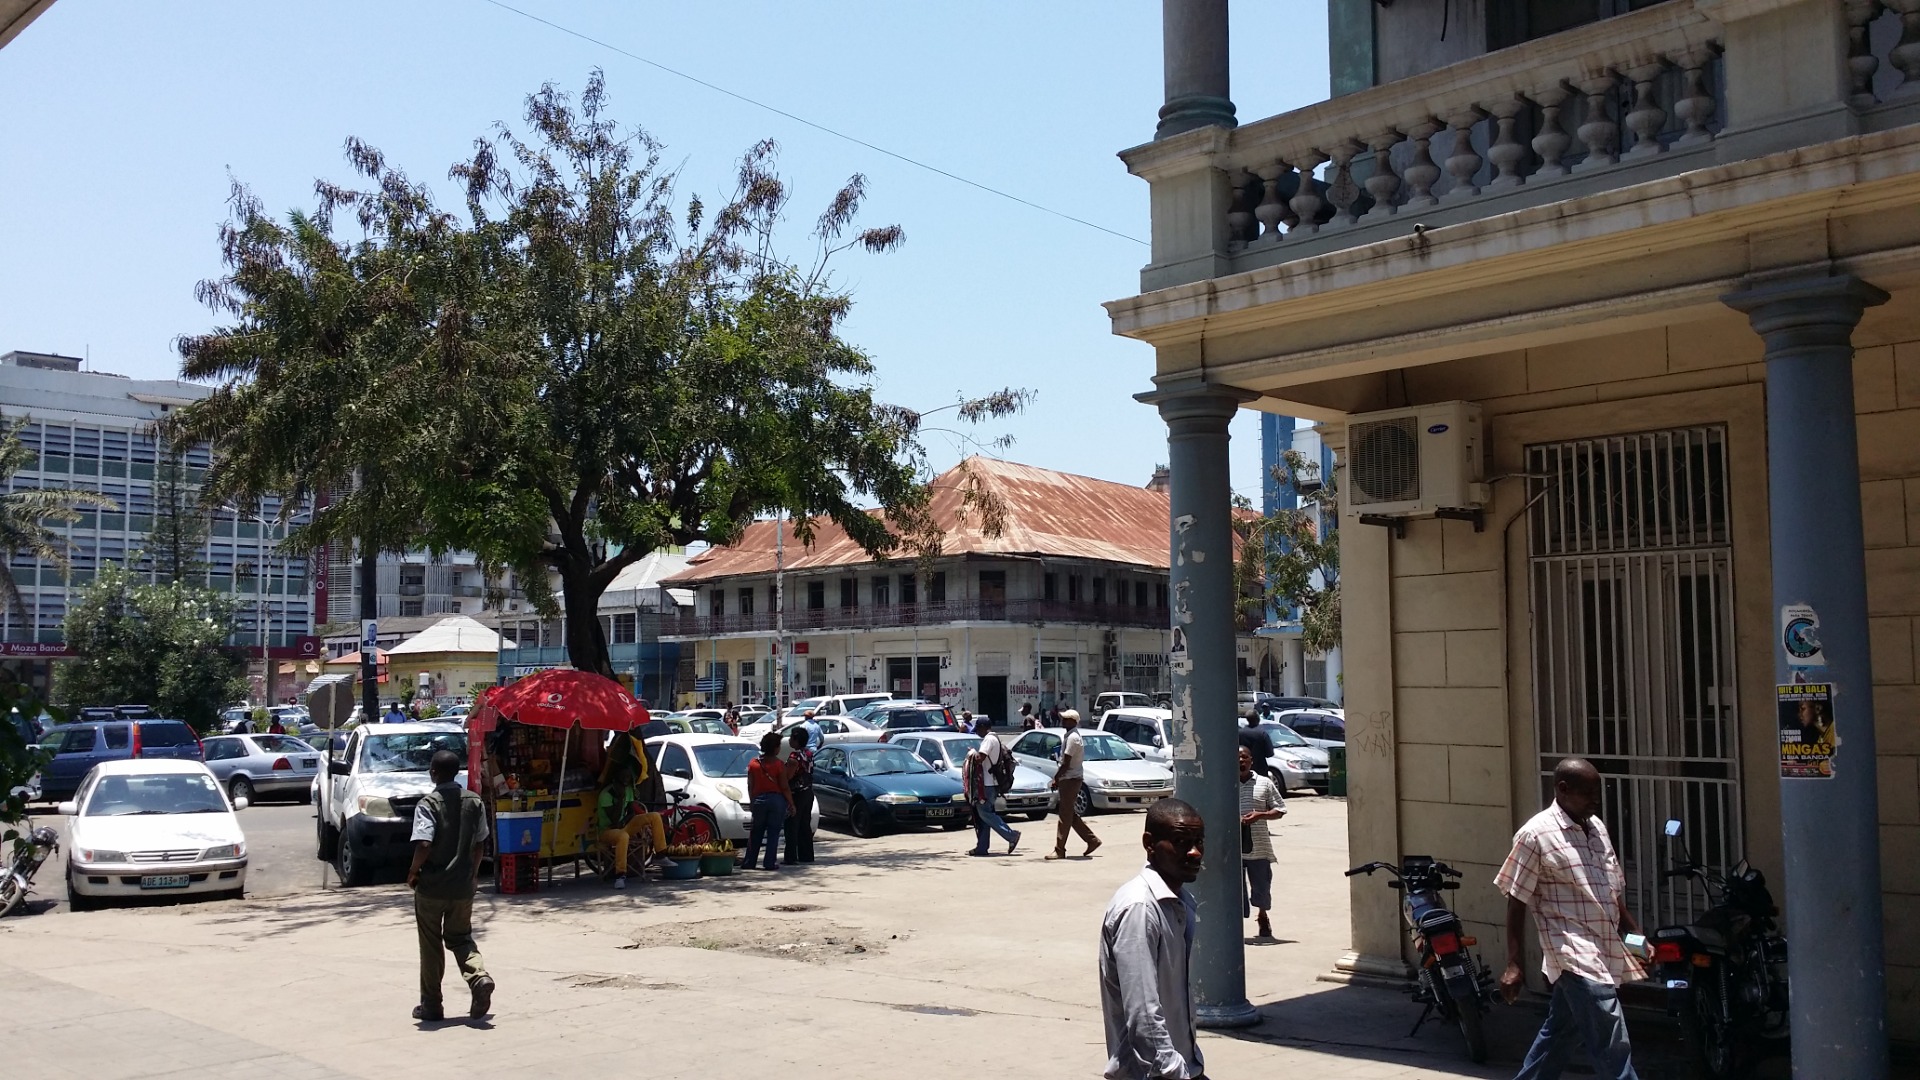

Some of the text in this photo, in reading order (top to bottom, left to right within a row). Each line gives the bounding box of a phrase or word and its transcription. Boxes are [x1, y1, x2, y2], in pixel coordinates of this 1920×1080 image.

[11, 644, 66, 652] Moza Banco
[1136, 654, 1170, 665] HUMANA
[1805, 685, 1827, 693] GALA
[1782, 744, 1831, 755] MINGAS
[158, 876, 173, 886] 113
